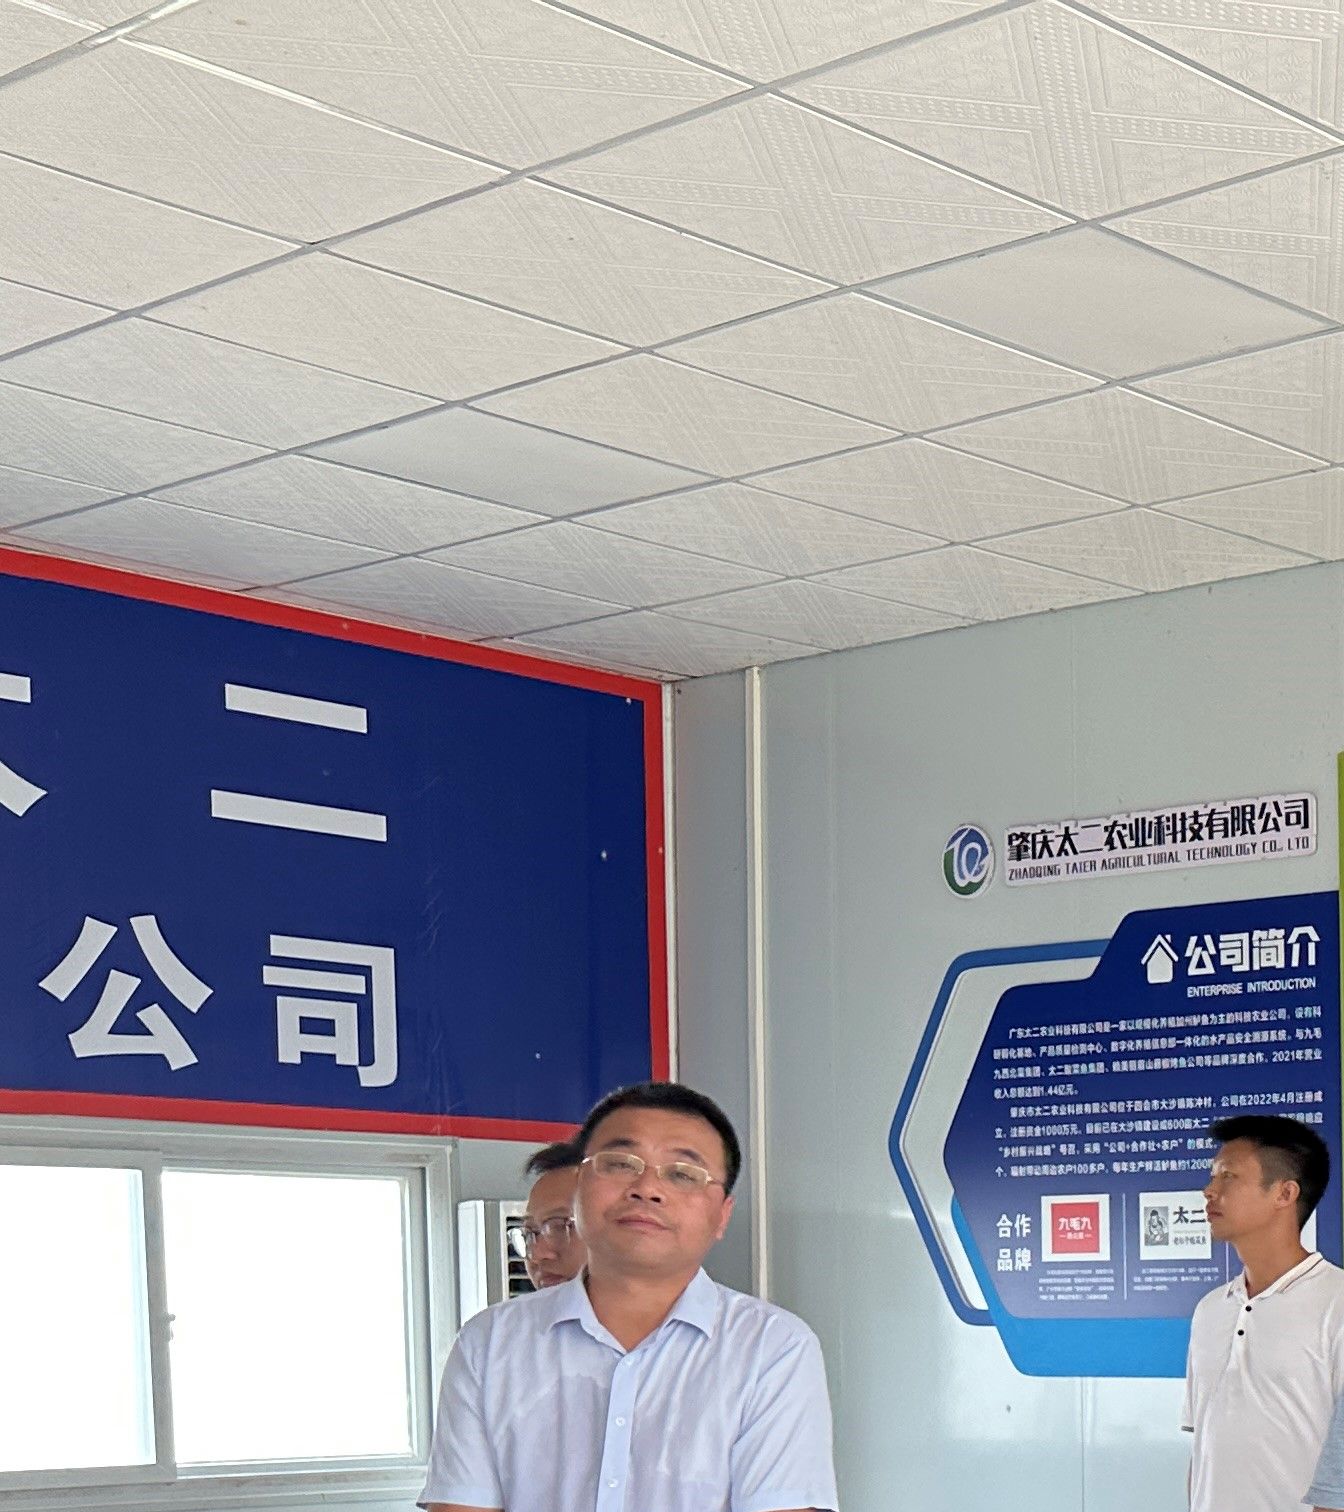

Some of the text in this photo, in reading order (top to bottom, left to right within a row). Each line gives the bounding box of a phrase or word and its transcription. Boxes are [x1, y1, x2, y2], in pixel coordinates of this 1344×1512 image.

[1007, 798, 1310, 862] 肇庆太二农业科技有限公司
[1065, 861, 1097, 877] TAIER
[1101, 852, 1181, 871] AGRICULTURAL
[1186, 843, 1257, 861] TECHNOLOGY
[1287, 836, 1310, 850] LTD
[1184, 926, 1321, 977] 公司简介
[1187, 976, 1316, 998] ENTERPRISE INTRODUCTION
[38, 914, 398, 1087] 公司
[996, 1213, 1032, 1239] 合作
[1057, 1216, 1093, 1231] 九毛九
[1173, 1206, 1207, 1225] 太二
[996, 1248, 1032, 1272] 品牌
